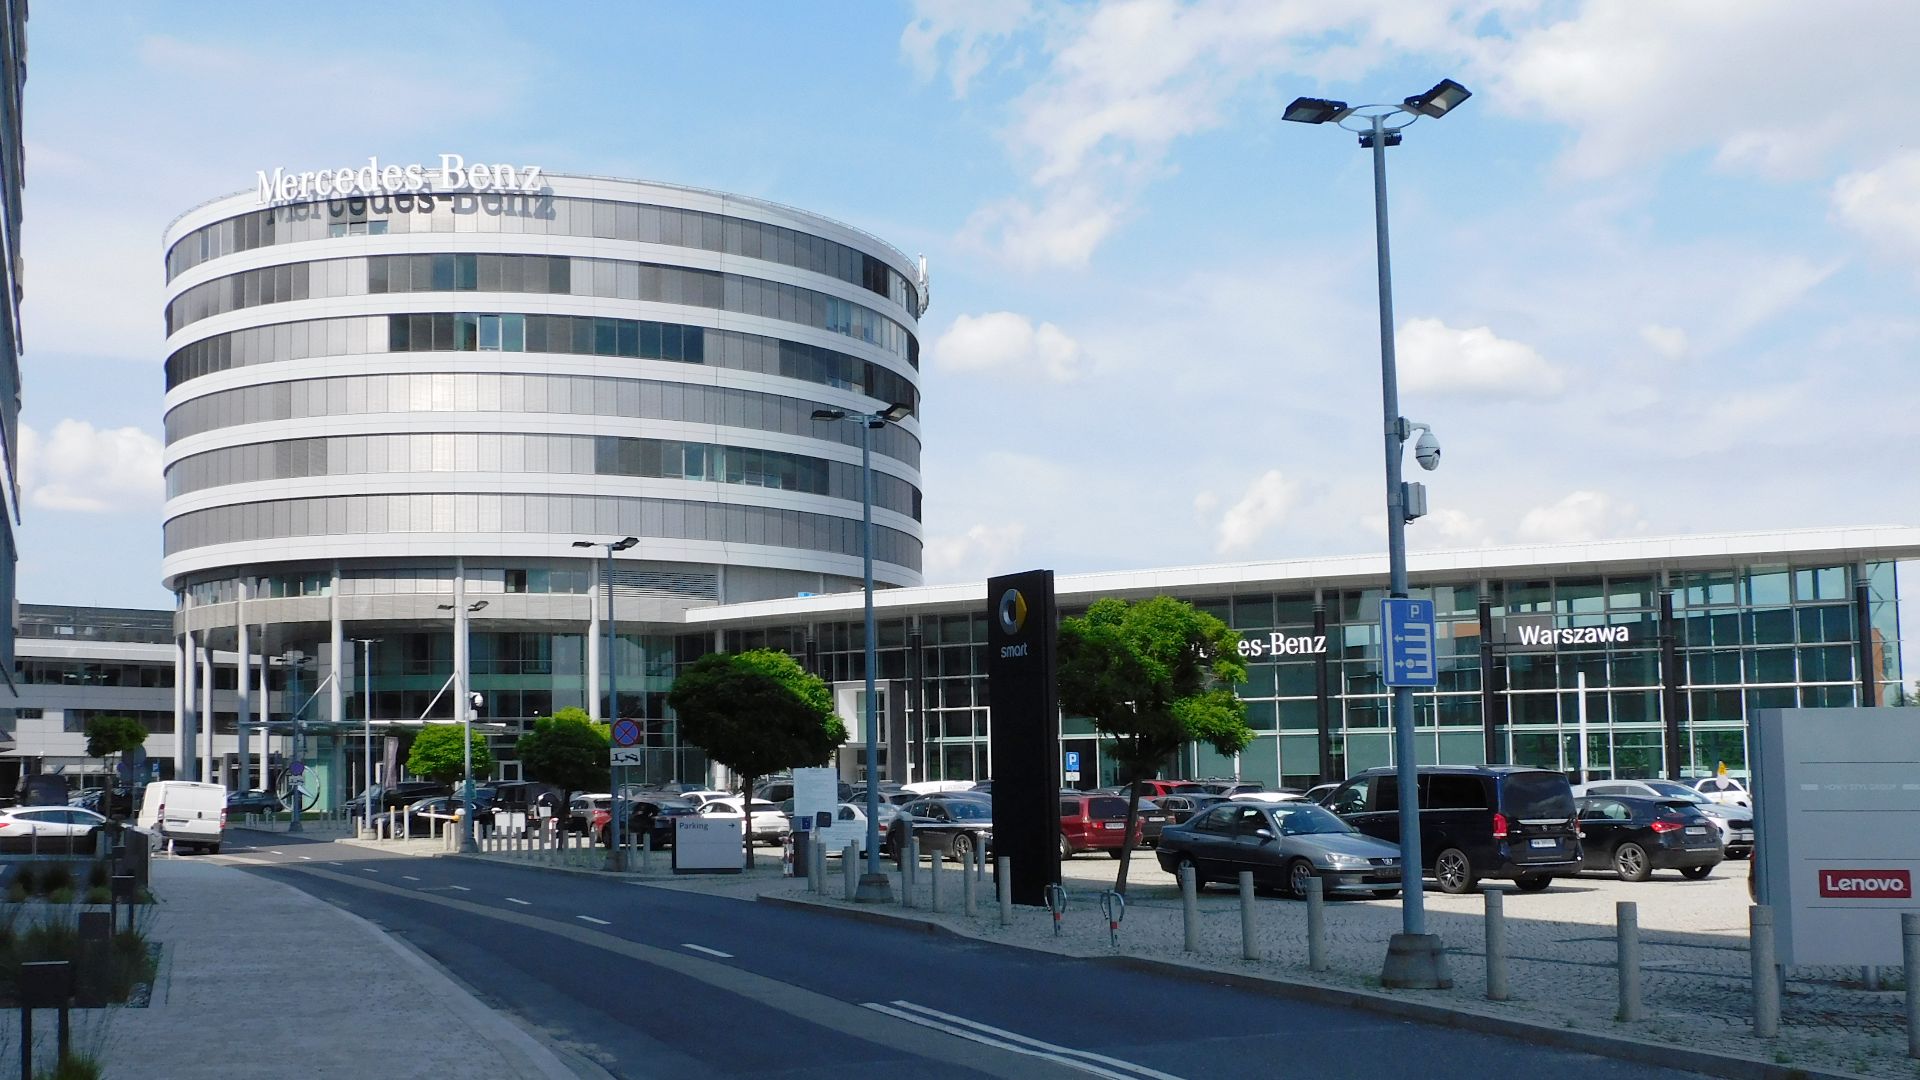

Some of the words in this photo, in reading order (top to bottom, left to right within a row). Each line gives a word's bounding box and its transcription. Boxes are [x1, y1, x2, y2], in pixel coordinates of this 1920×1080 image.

[1410, 604, 1420, 619] P
[1518, 625, 1629, 646] Warszawa
[1000, 642, 1028, 658] smart
[1191, 632, 1327, 658] es-Benz
[1069, 753, 1077, 766] P
[679, 822, 709, 831] Parking
[1826, 875, 1904, 891] Lenovo
